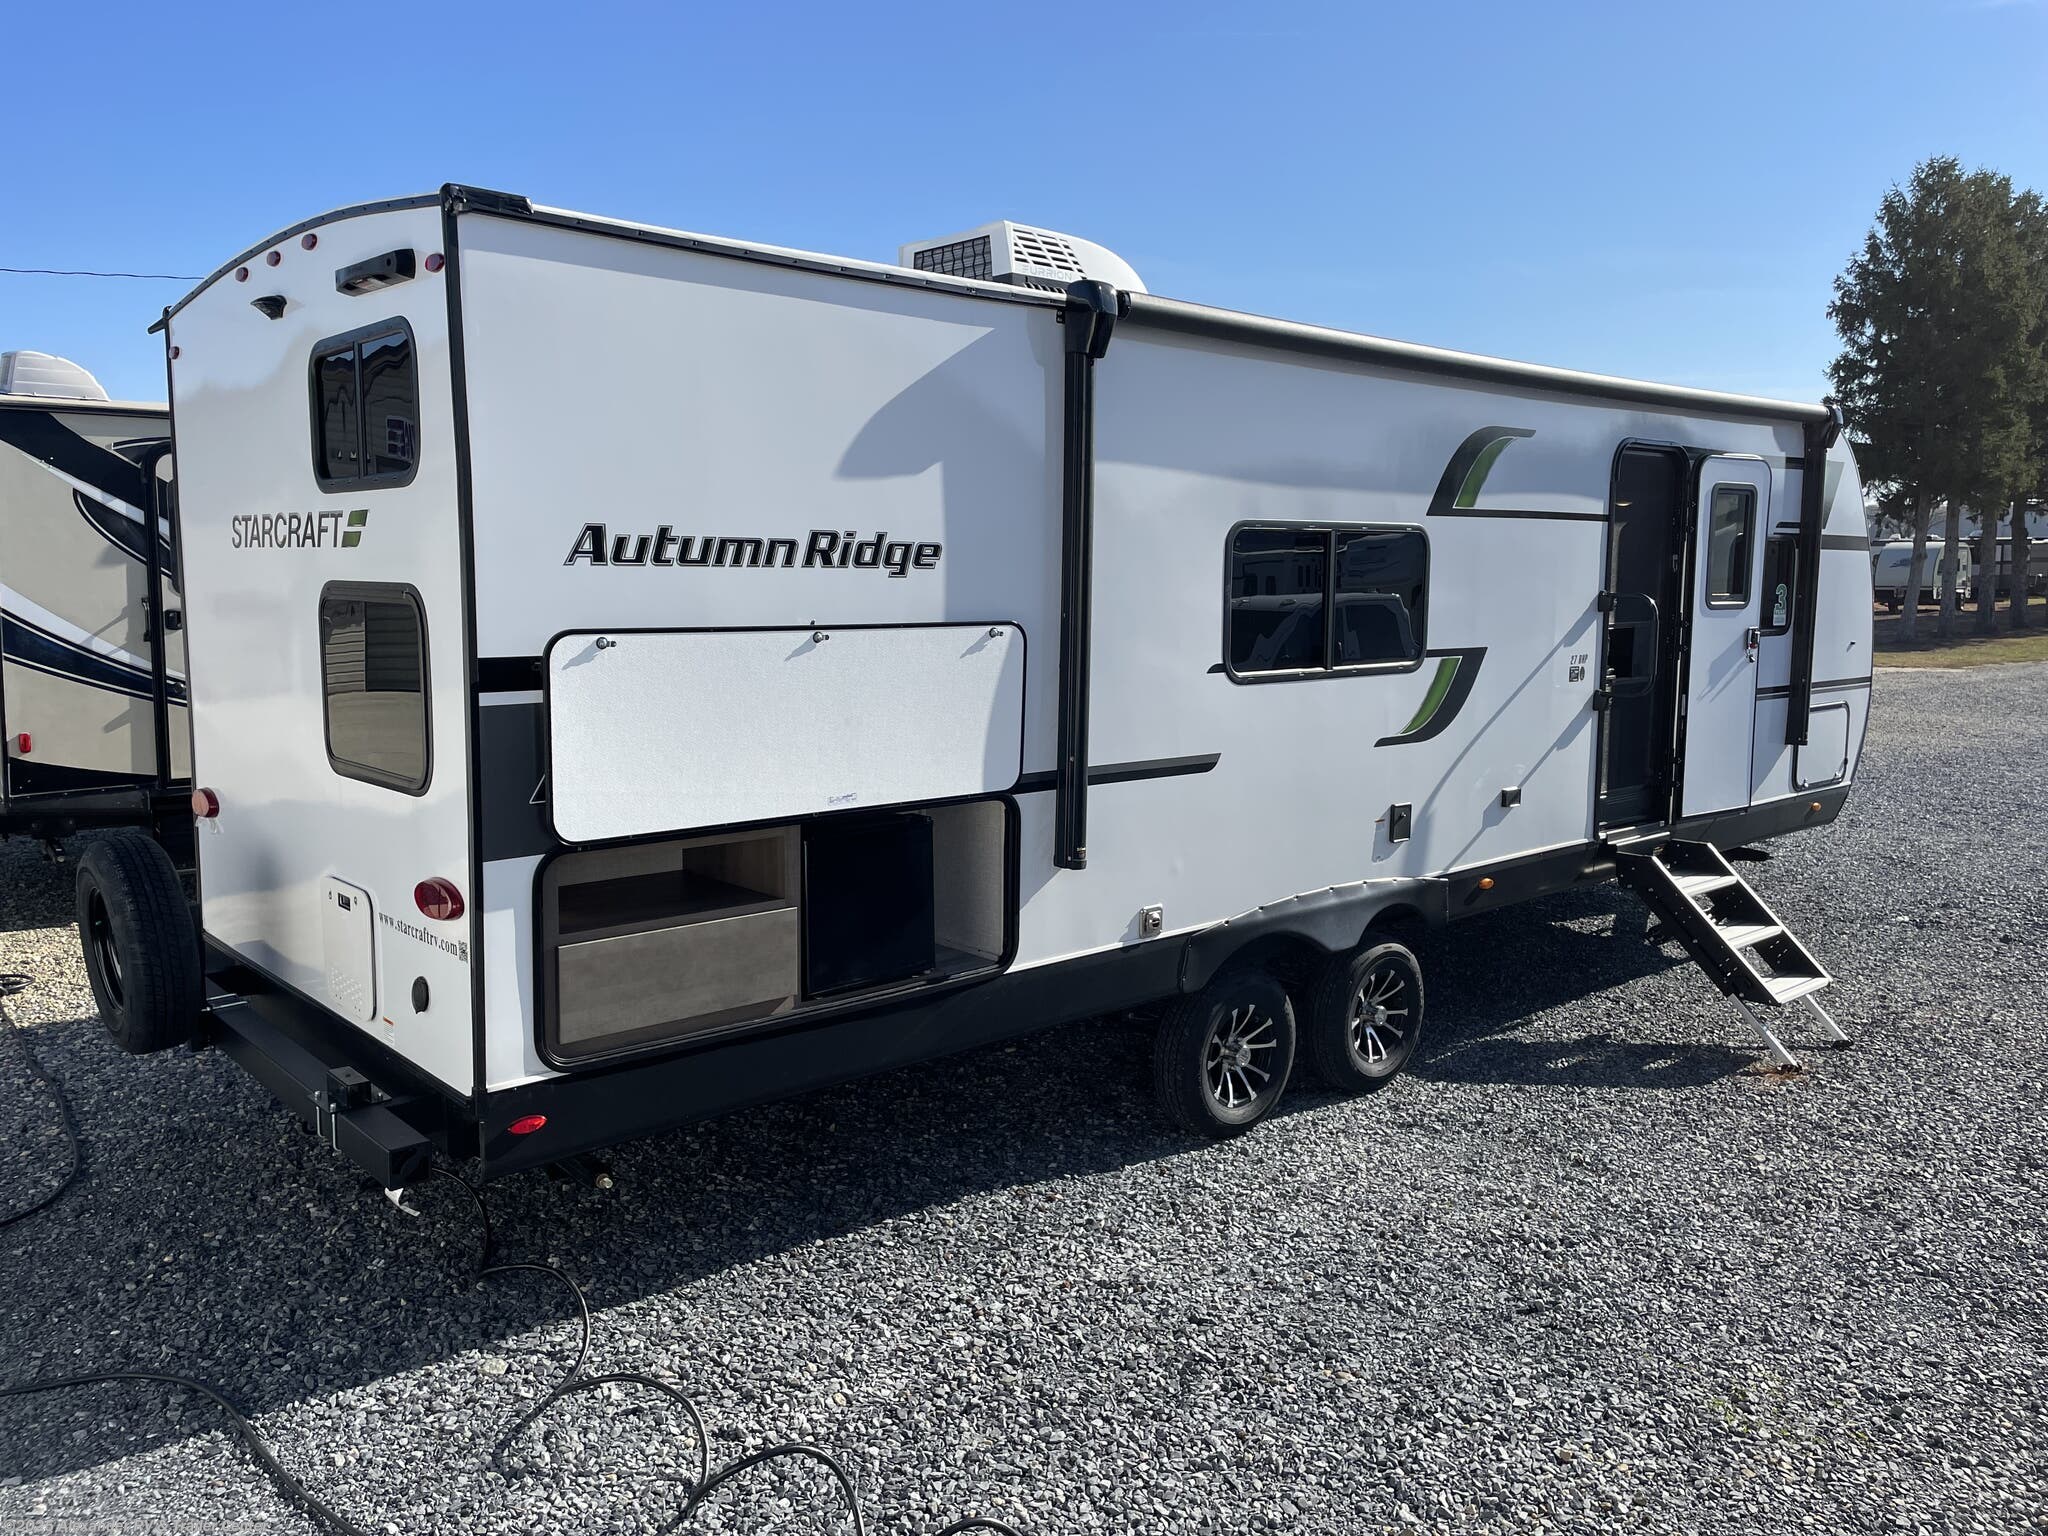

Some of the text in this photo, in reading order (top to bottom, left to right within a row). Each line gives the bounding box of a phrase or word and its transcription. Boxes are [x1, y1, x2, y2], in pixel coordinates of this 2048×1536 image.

[1022, 264, 1073, 280] FURRION
[232, 510, 344, 548] STARCRAFT
[563, 522, 942, 579] Autumn Ridge
[1775, 583, 1788, 609] 3
[378, 912, 458, 957] www.starcraftrv.com
